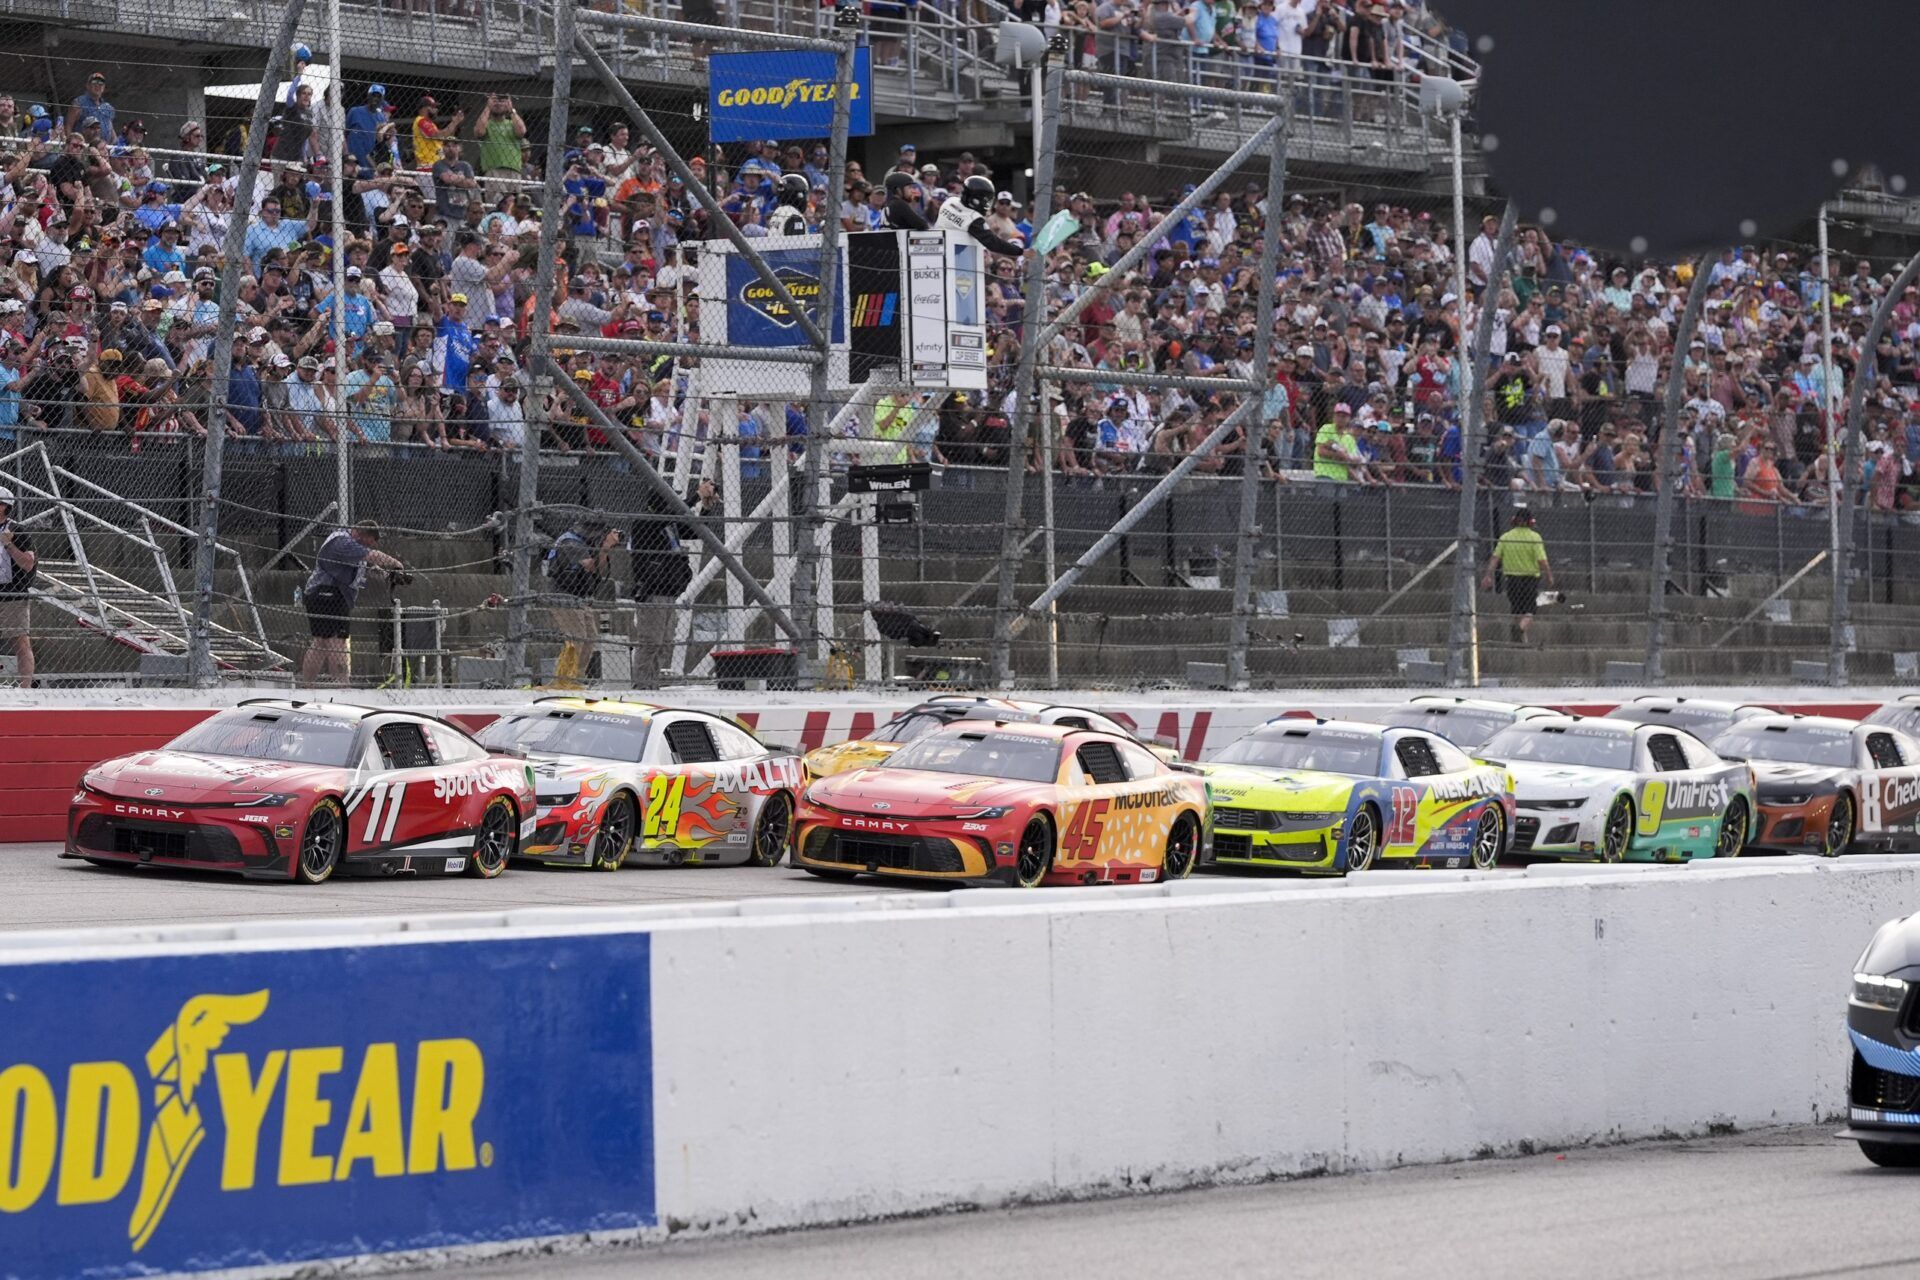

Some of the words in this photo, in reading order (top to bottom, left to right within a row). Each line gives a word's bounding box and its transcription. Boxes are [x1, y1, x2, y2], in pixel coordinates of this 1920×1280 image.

[914, 271, 940, 279] BUSCH
[747, 283, 820, 298] GOOYEA
[914, 294, 941, 304] Coca-Cola
[914, 342, 943, 352] xfinity
[291, 716, 351, 729] HAMLIN
[584, 713, 630, 724] BYRON
[997, 712, 1027, 721] BELL
[993, 733, 1049, 745] REDDICK
[1574, 728, 1622, 739] ELLIOTT
[711, 758, 801, 793] AXALTA
[1666, 777, 1730, 809] UniFirst
[1884, 771, 1920, 810] Ched
[643, 774, 686, 837] 24
[1638, 779, 1668, 836] 9
[1862, 772, 1882, 832] 8
[115, 804, 185, 819] CAMRY
[238, 814, 269, 823] JGR
[362, 781, 407, 843] 11
[1389, 786, 1418, 847] 12
[842, 818, 910, 831] CAMRY
[1062, 798, 1111, 860] 45
